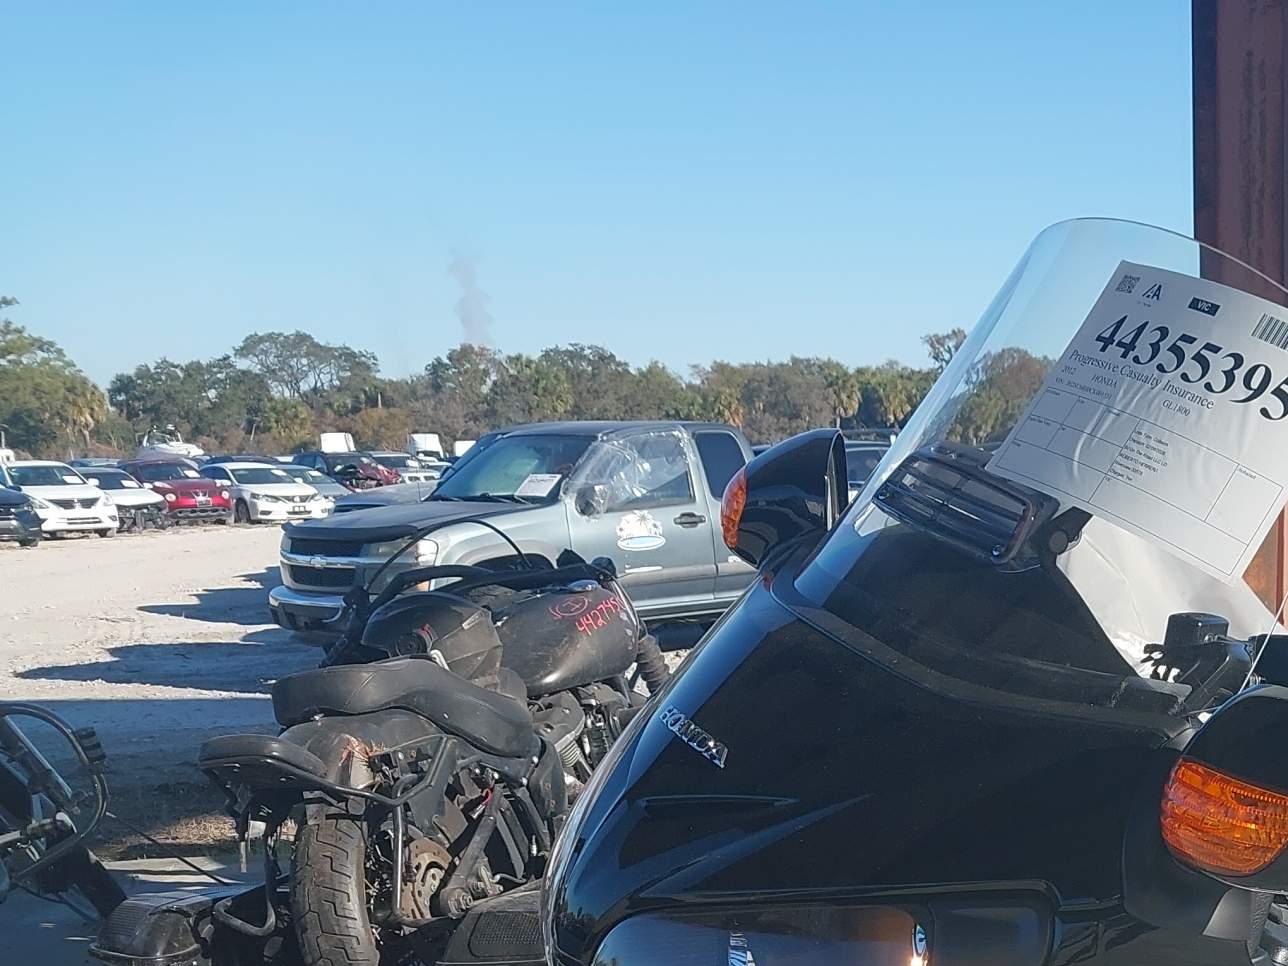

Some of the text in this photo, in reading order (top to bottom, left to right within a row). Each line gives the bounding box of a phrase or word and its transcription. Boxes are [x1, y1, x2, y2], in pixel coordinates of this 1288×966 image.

[1197, 301, 1212, 312] VIC
[1068, 350, 1120, 374] Progressive
[1120, 364, 1162, 390] Casualty
[1162, 379, 1214, 410] Insurance
[1091, 374, 1118, 389] HONDA
[1162, 399, 1191, 417] GL1800
[660, 705, 729, 769] HONDA
